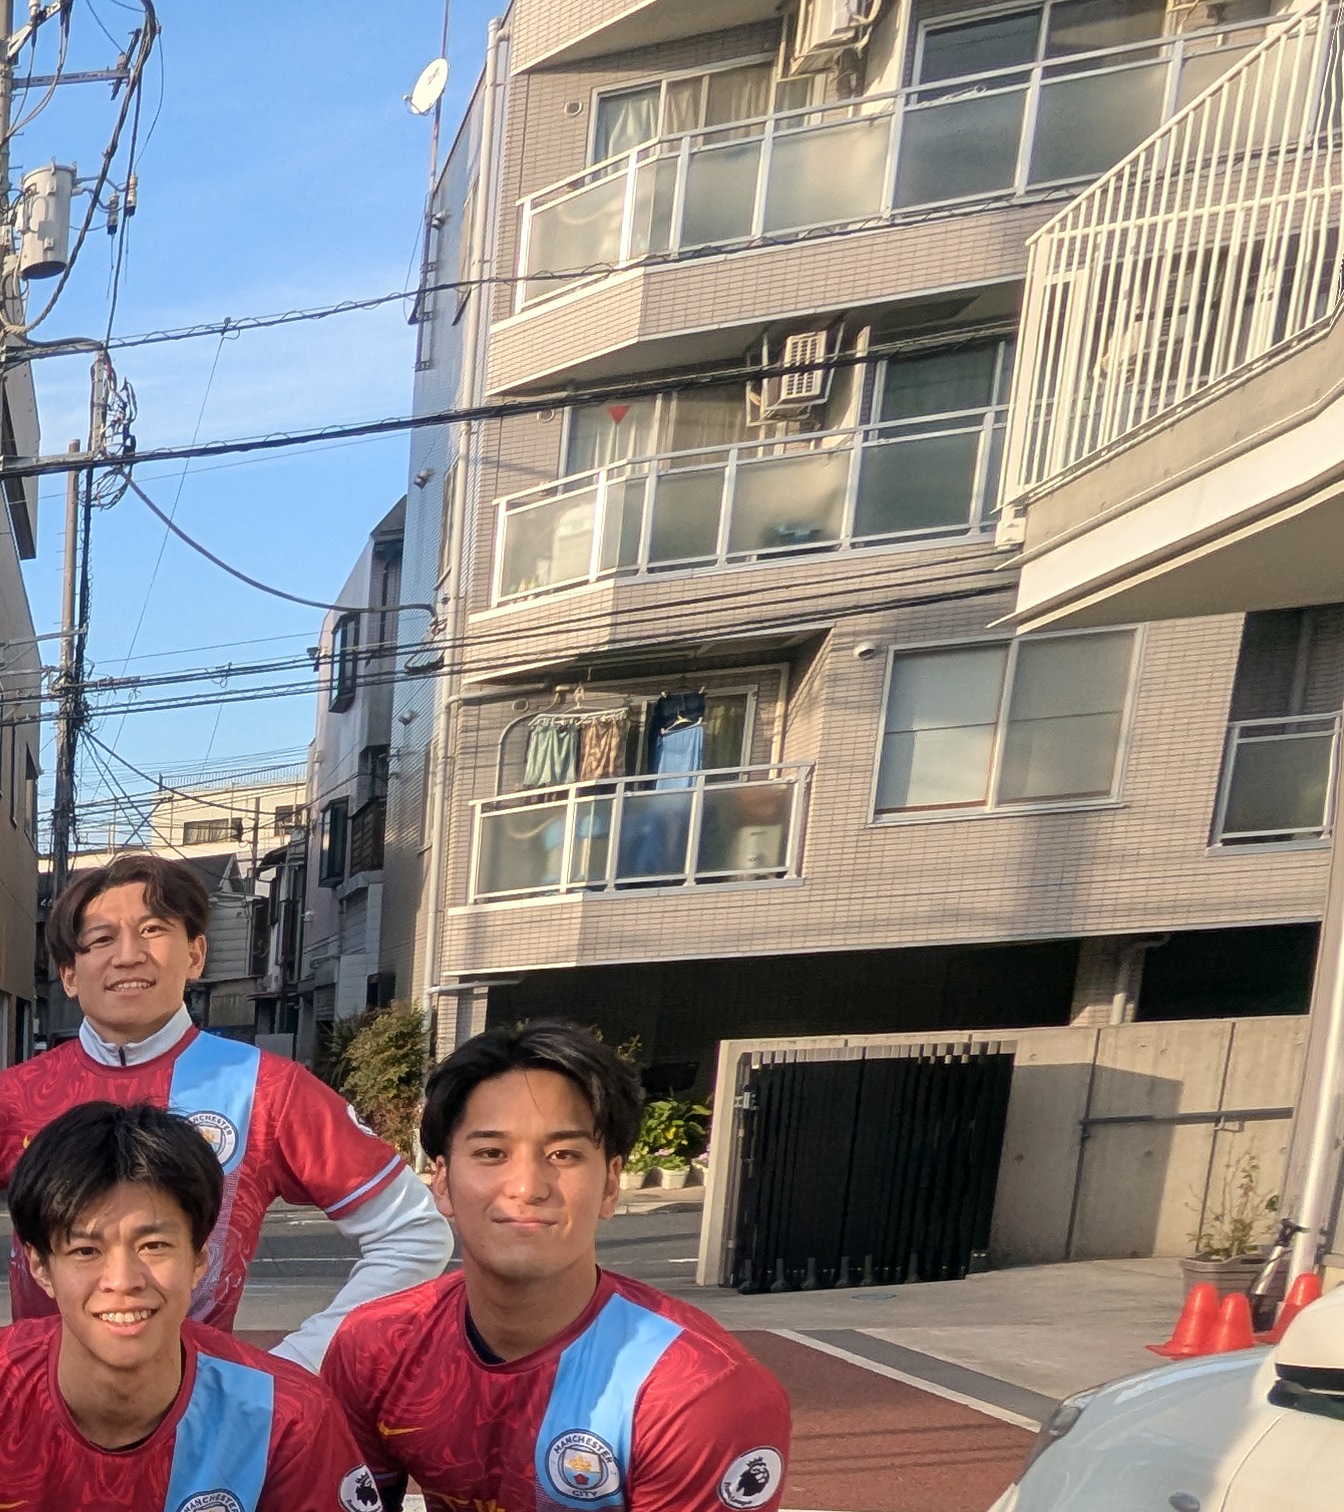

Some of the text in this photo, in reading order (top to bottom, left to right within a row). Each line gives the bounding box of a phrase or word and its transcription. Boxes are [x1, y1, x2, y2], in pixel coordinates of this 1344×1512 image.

[192, 1114, 233, 1136] NCHESTER
[552, 1434, 614, 1499] MANCHESTER CITY
